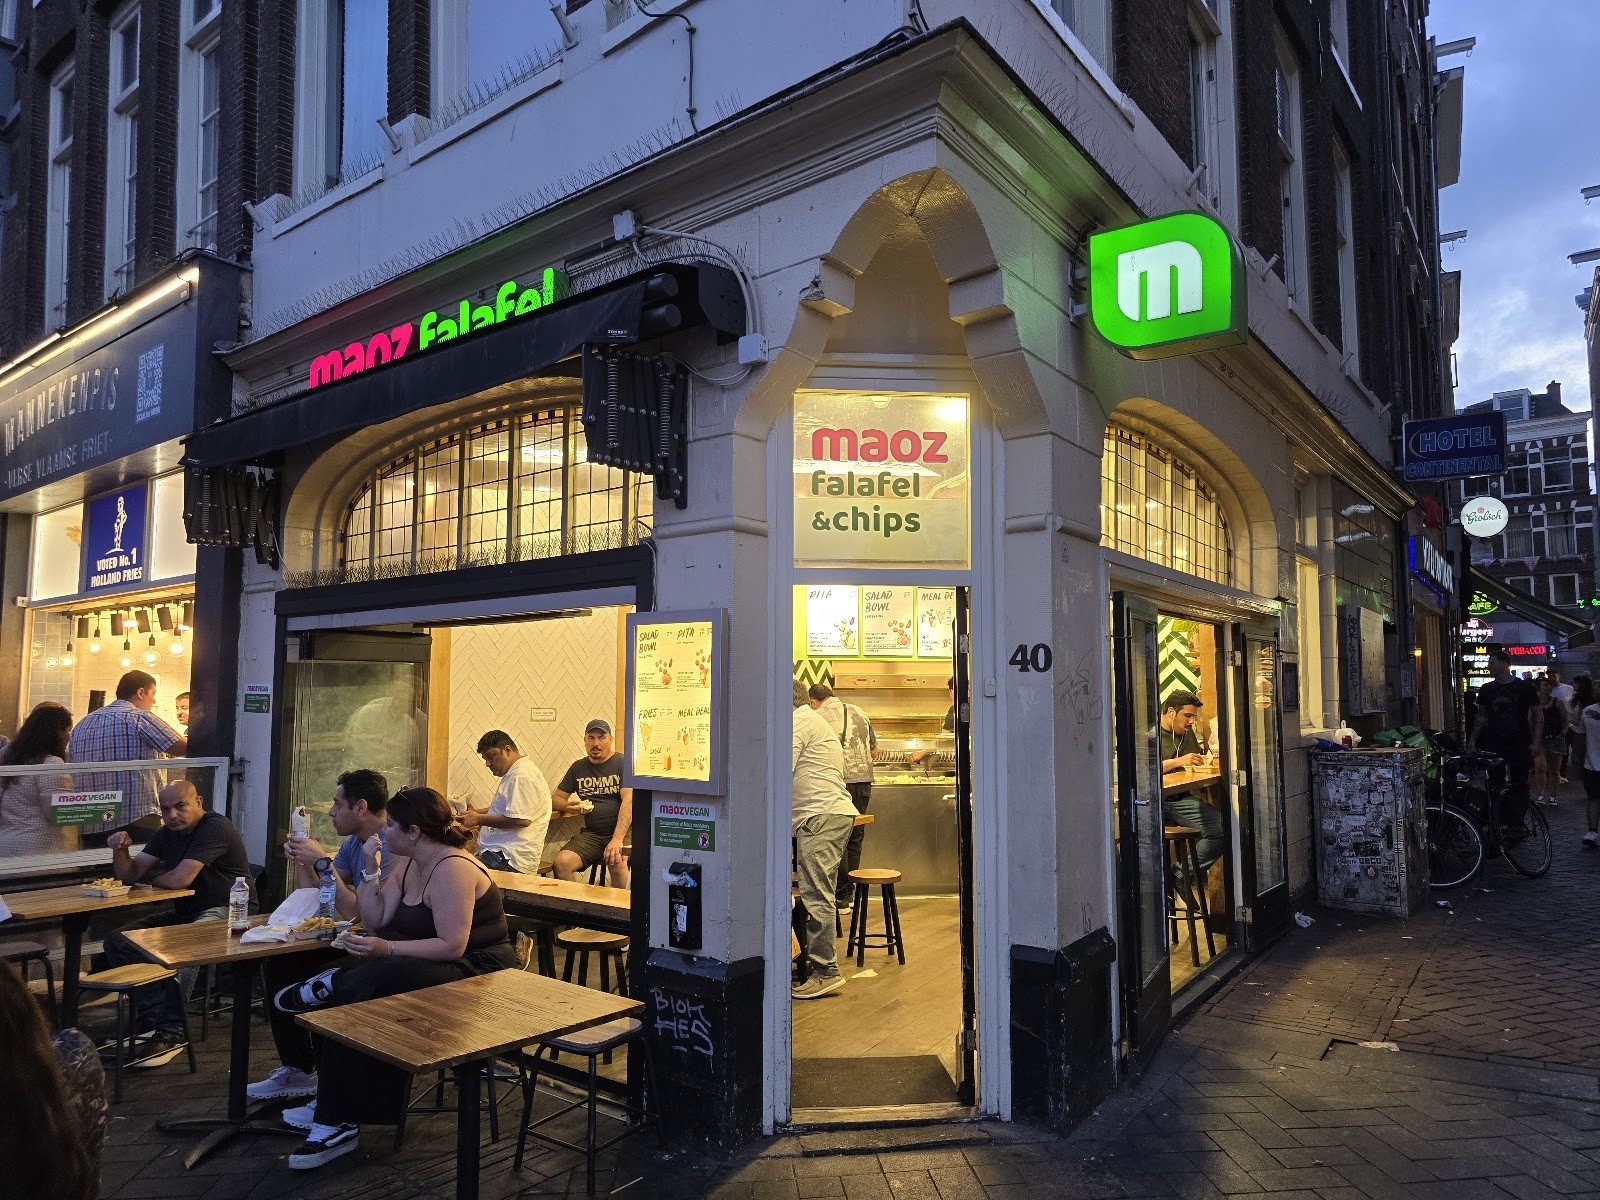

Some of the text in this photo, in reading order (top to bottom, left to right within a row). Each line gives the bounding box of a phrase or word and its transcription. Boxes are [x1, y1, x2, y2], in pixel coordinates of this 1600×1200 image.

[811, 427, 949, 464] maoz
[1420, 425, 1497, 453] HOTEL
[1406, 455, 1503, 478] CONTINENTAL
[811, 470, 920, 497] falafel
[811, 505, 921, 538] &chips
[1466, 509, 1502, 525] Grolsch
[97, 547, 137, 572] VOTED No. 1
[91, 567, 142, 588] HOLLAND FRIES
[865, 590, 893, 601] SALAD
[921, 592, 942, 601] MEAL
[865, 602, 890, 613] BOWL
[639, 629, 659, 642] SALAD
[677, 627, 695, 640] PITA
[639, 642, 657, 654] BOWL
[1508, 645, 1547, 656] TOBACCO
[1008, 642, 1053, 673] 40
[639, 707, 658, 719] FRIES
[677, 707, 694, 718] MEAL
[576, 774, 620, 789] TOMMY
